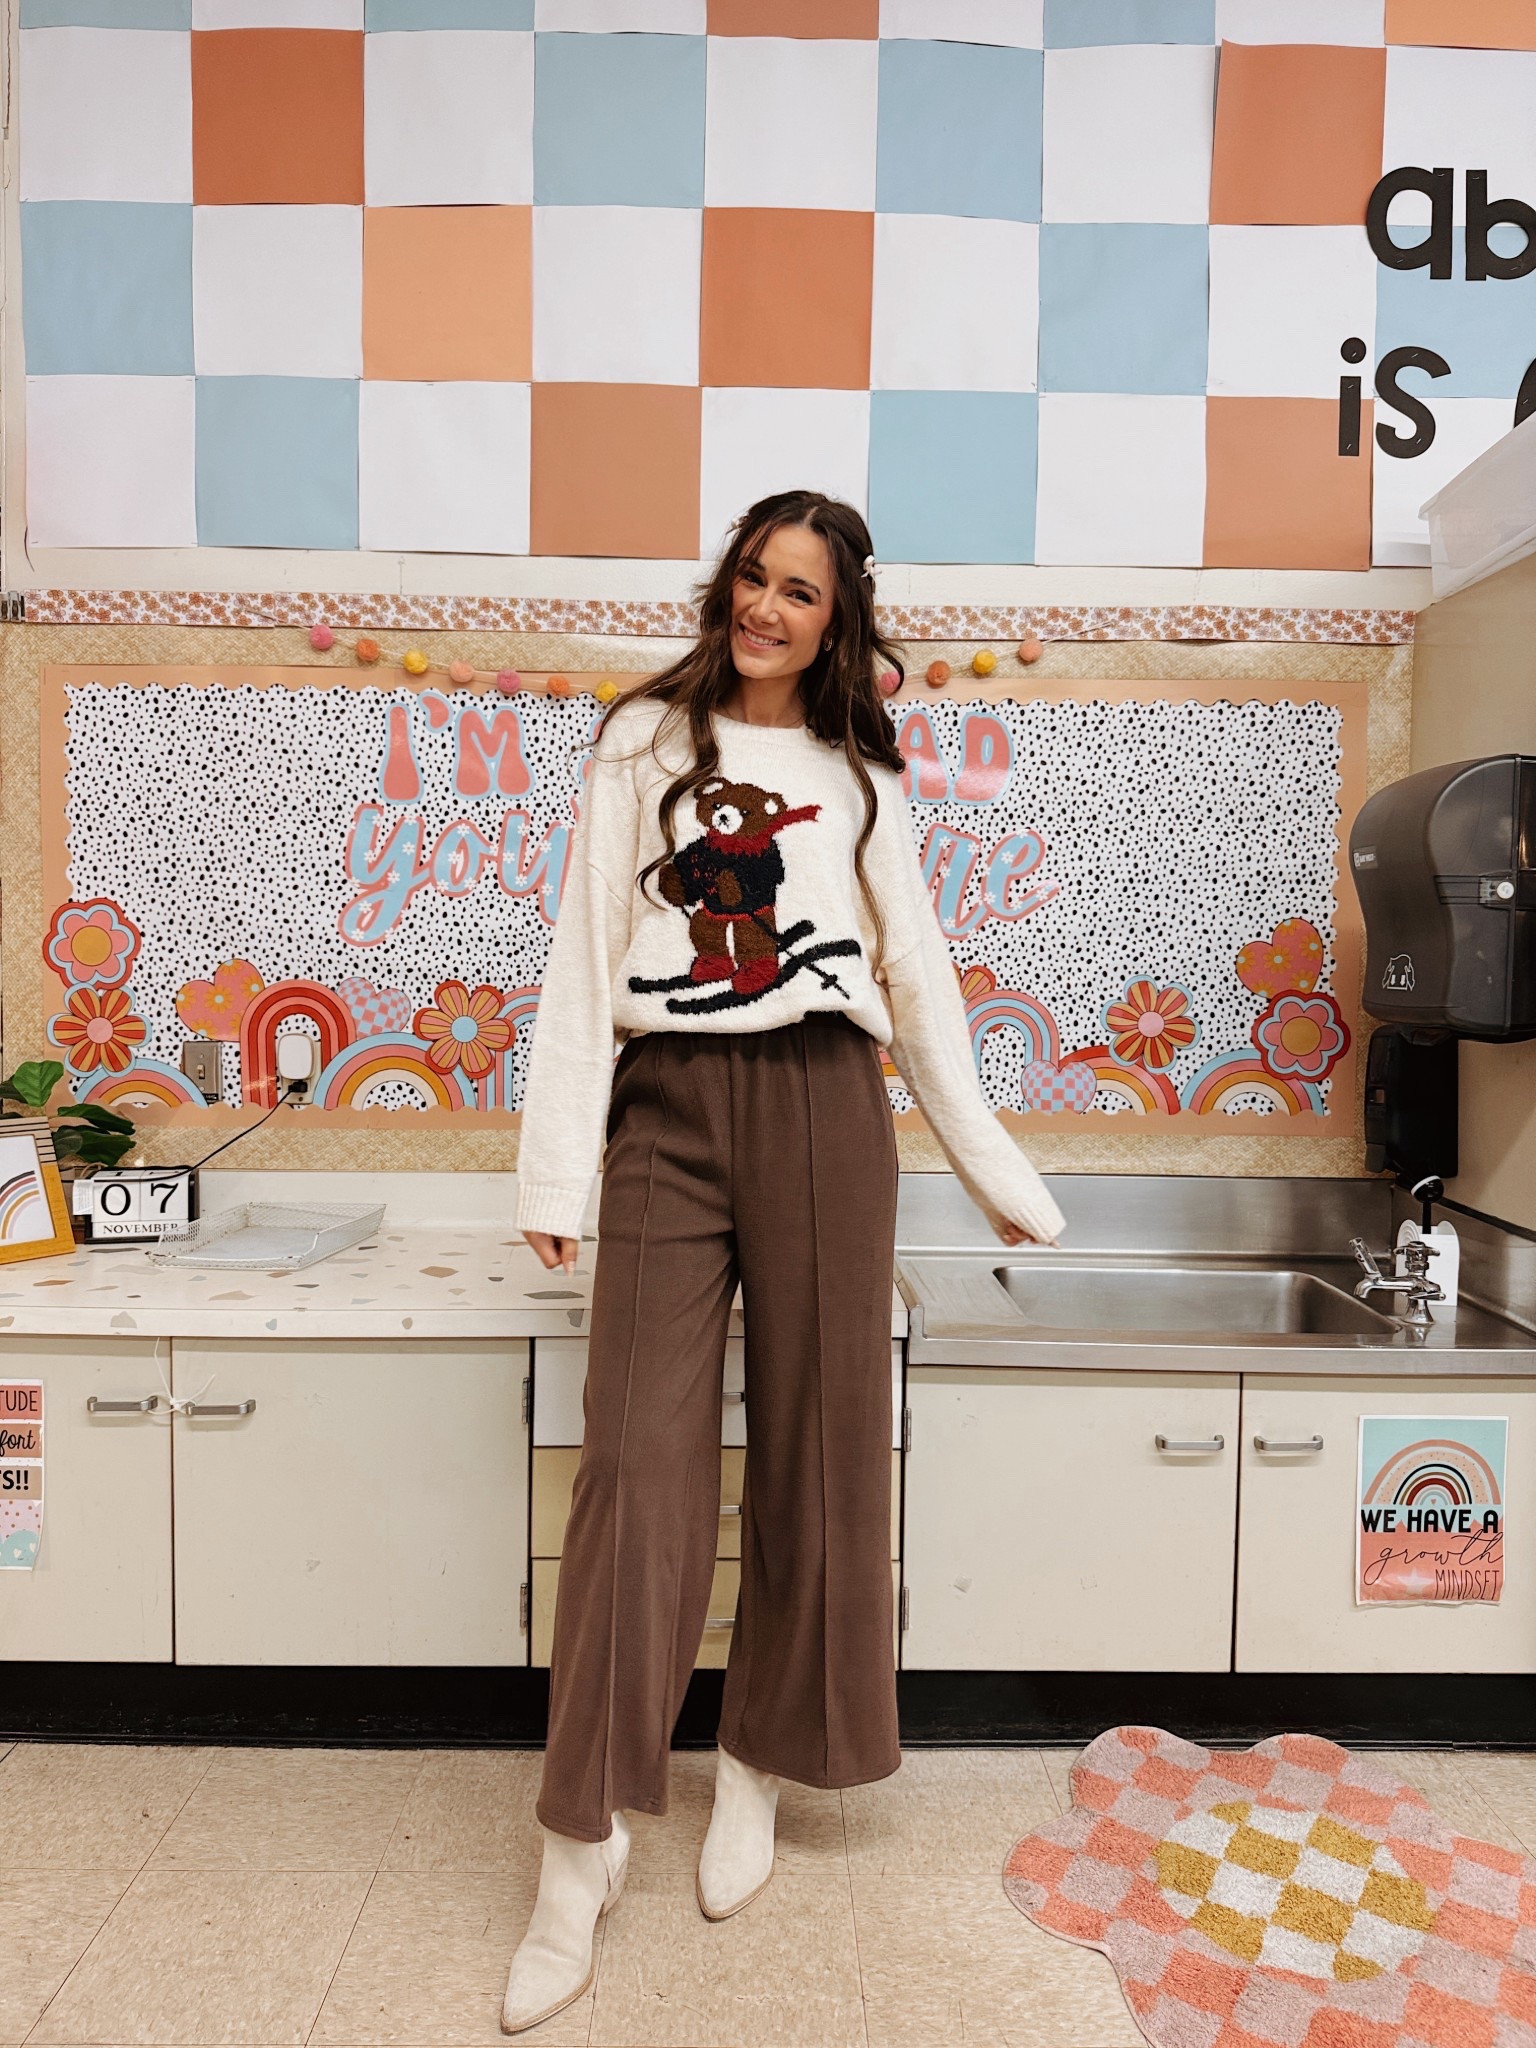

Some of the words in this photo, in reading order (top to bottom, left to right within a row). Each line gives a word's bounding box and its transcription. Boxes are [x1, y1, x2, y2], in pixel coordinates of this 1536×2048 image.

[1338, 336, 1451, 459] is
[378, 691, 537, 805] I'M
[103, 1223, 179, 1235] NOVEMBER
[1361, 1509, 1397, 1533] WE
[1407, 1509, 1471, 1533] HAVE
[1483, 1510, 1499, 1534] A
[1363, 1529, 1504, 1586] growth
[1434, 1569, 1500, 1601] MINDSET
